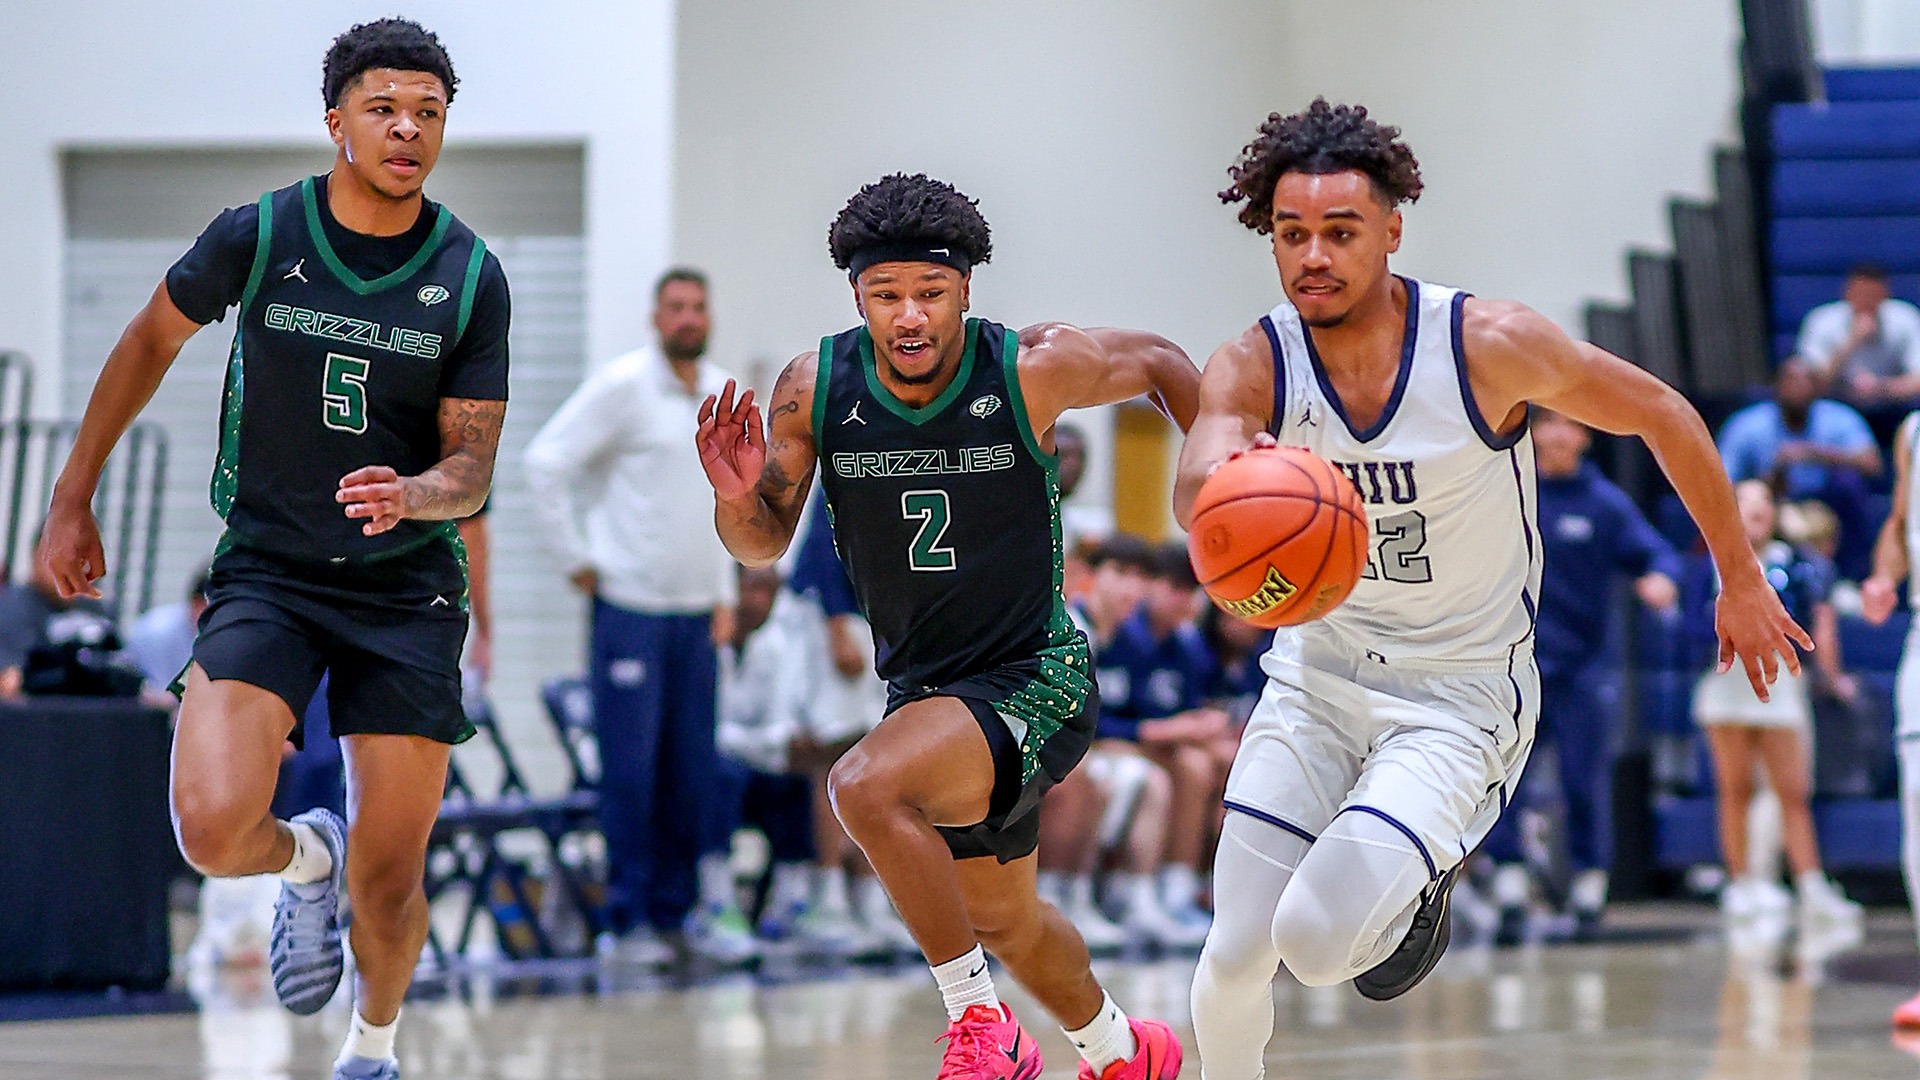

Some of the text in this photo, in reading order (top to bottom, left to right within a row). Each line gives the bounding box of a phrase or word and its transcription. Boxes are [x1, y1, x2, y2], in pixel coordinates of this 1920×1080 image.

[264, 303, 443, 360] GRIZZLIES
[322, 352, 371, 435] 5
[832, 443, 1015, 478] GRIZZLIES
[901, 489, 957, 571] 2
[1360, 509, 1433, 584] 2
[1214, 563, 1298, 618] NAI
